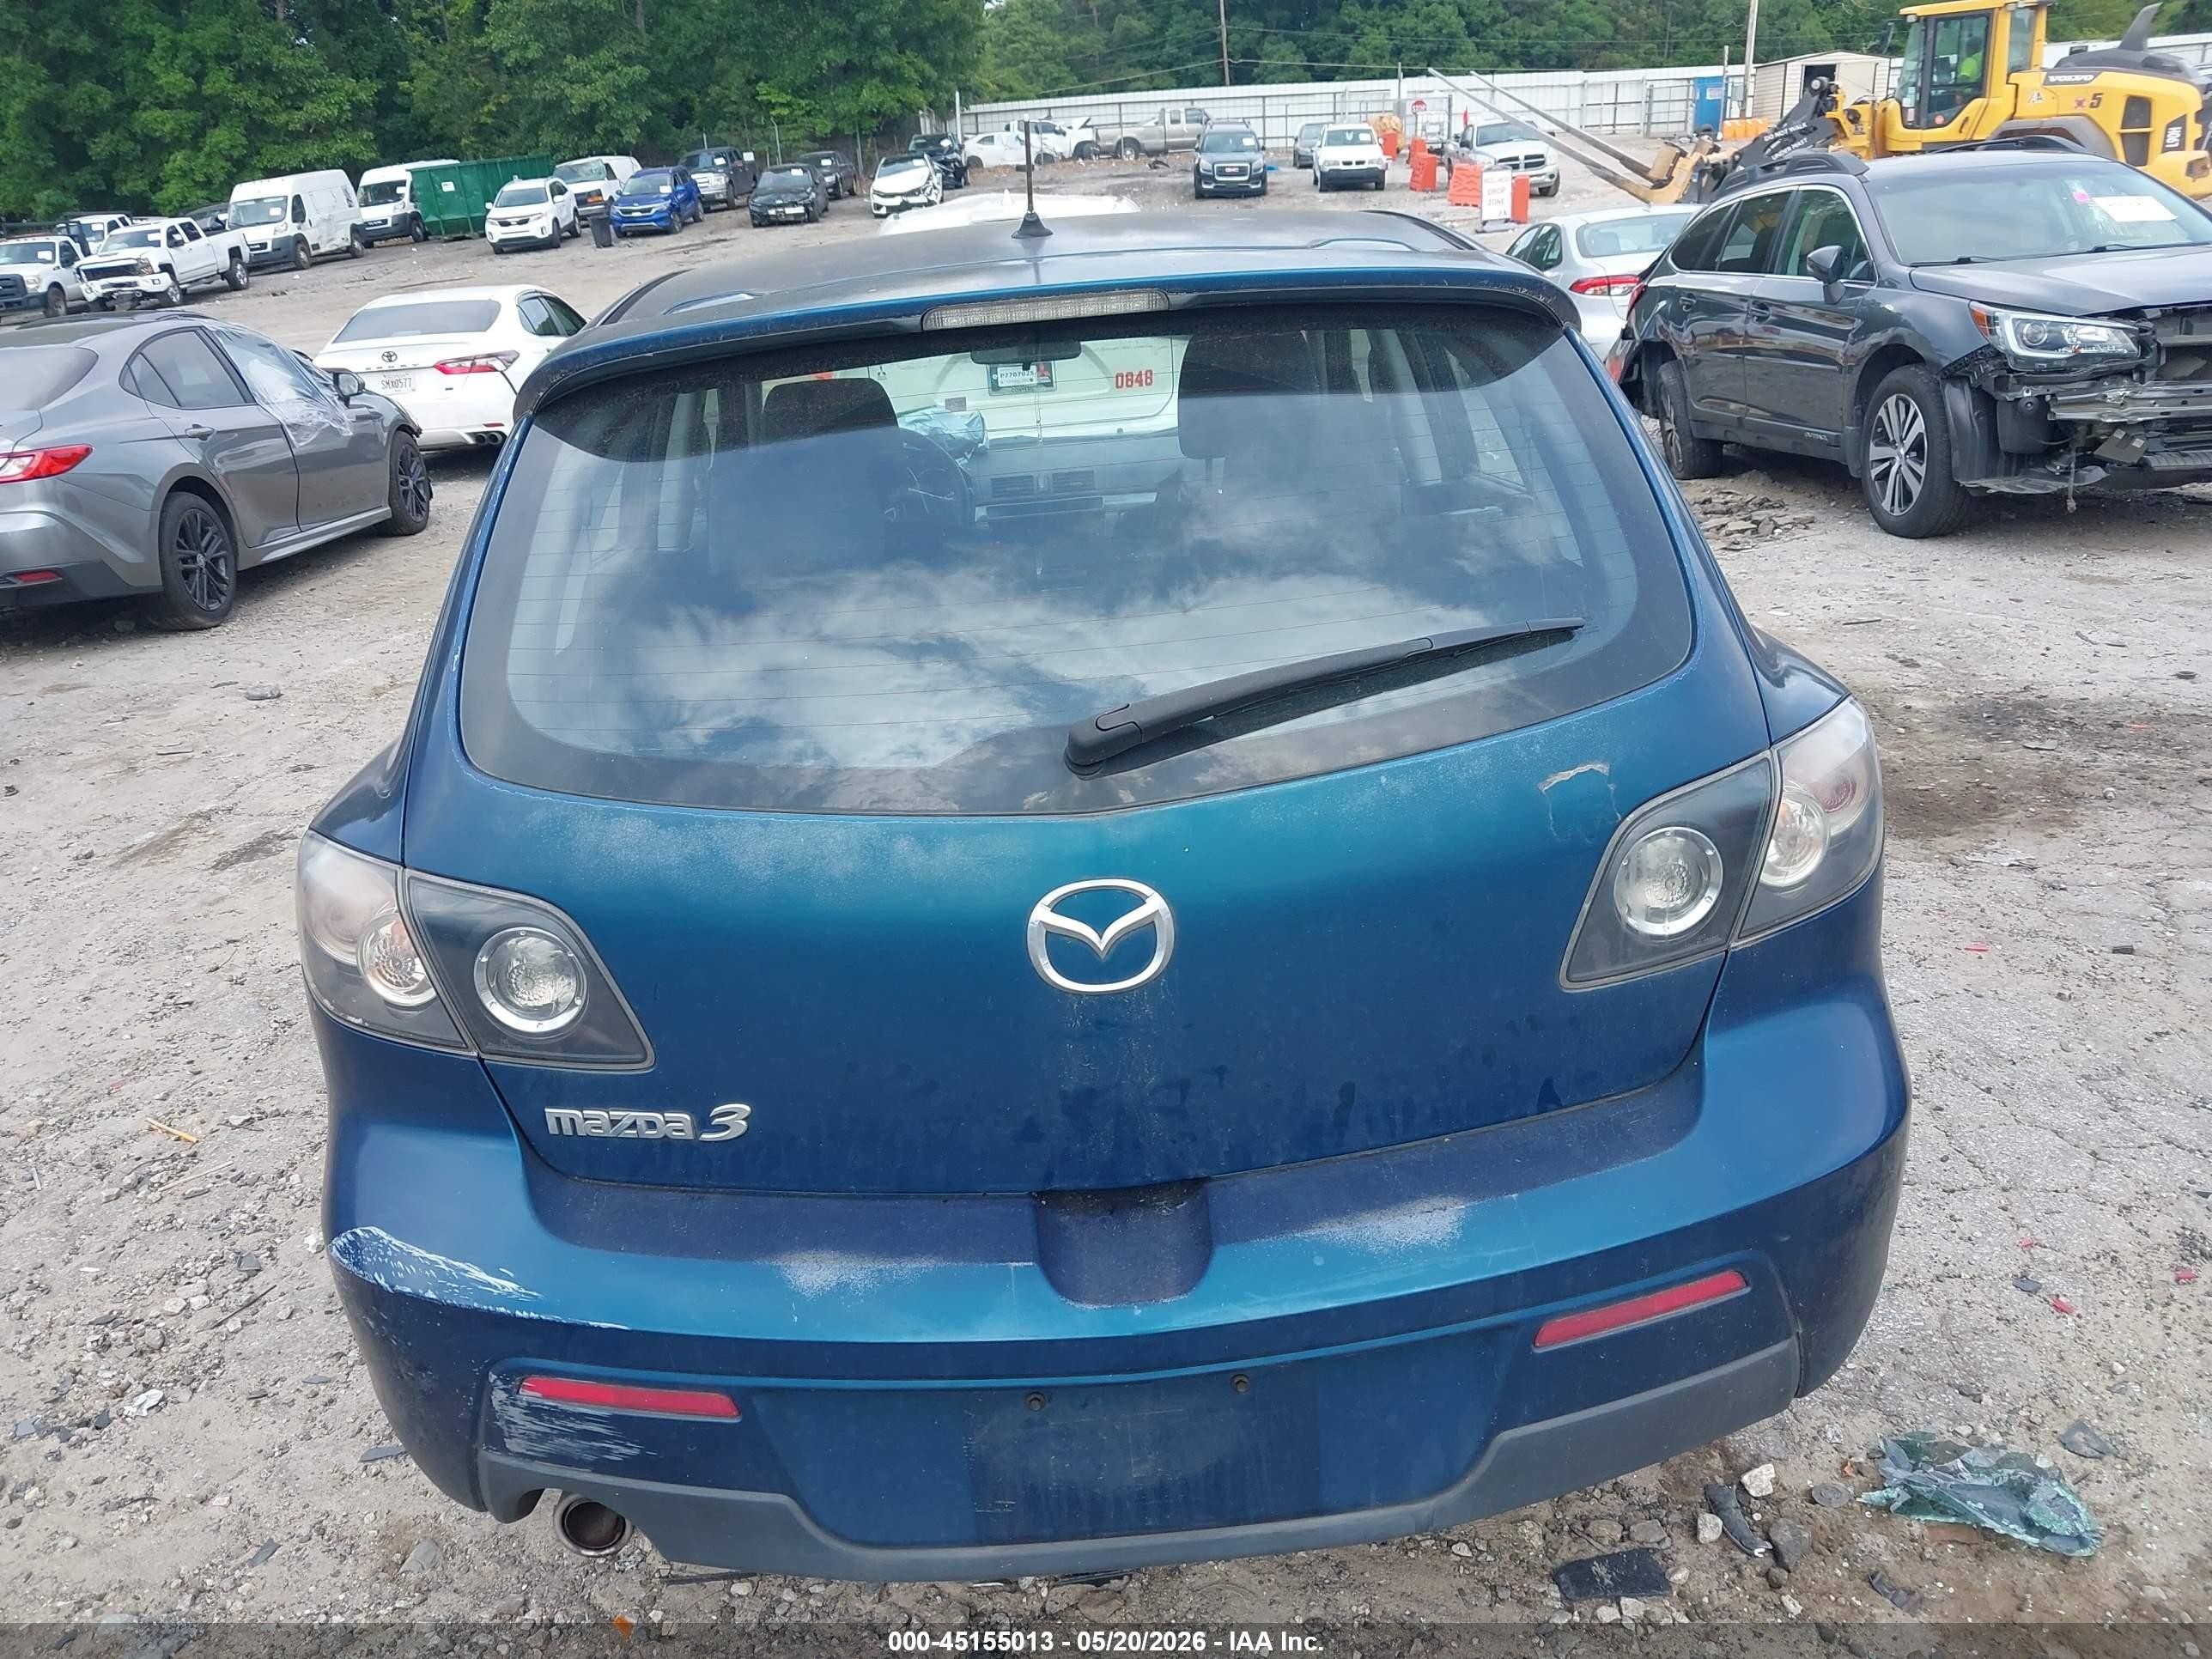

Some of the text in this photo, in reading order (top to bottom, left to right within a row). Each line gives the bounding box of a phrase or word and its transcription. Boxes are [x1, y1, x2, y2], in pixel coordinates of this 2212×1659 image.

[2089, 92, 2104, 108] 5
[1774, 129, 1788, 137] NOT
[1789, 122, 1808, 132] WALK
[2165, 126, 2183, 148] L90H
[1771, 146, 1792, 161] UNDER
[1115, 369, 1153, 389] 0848
